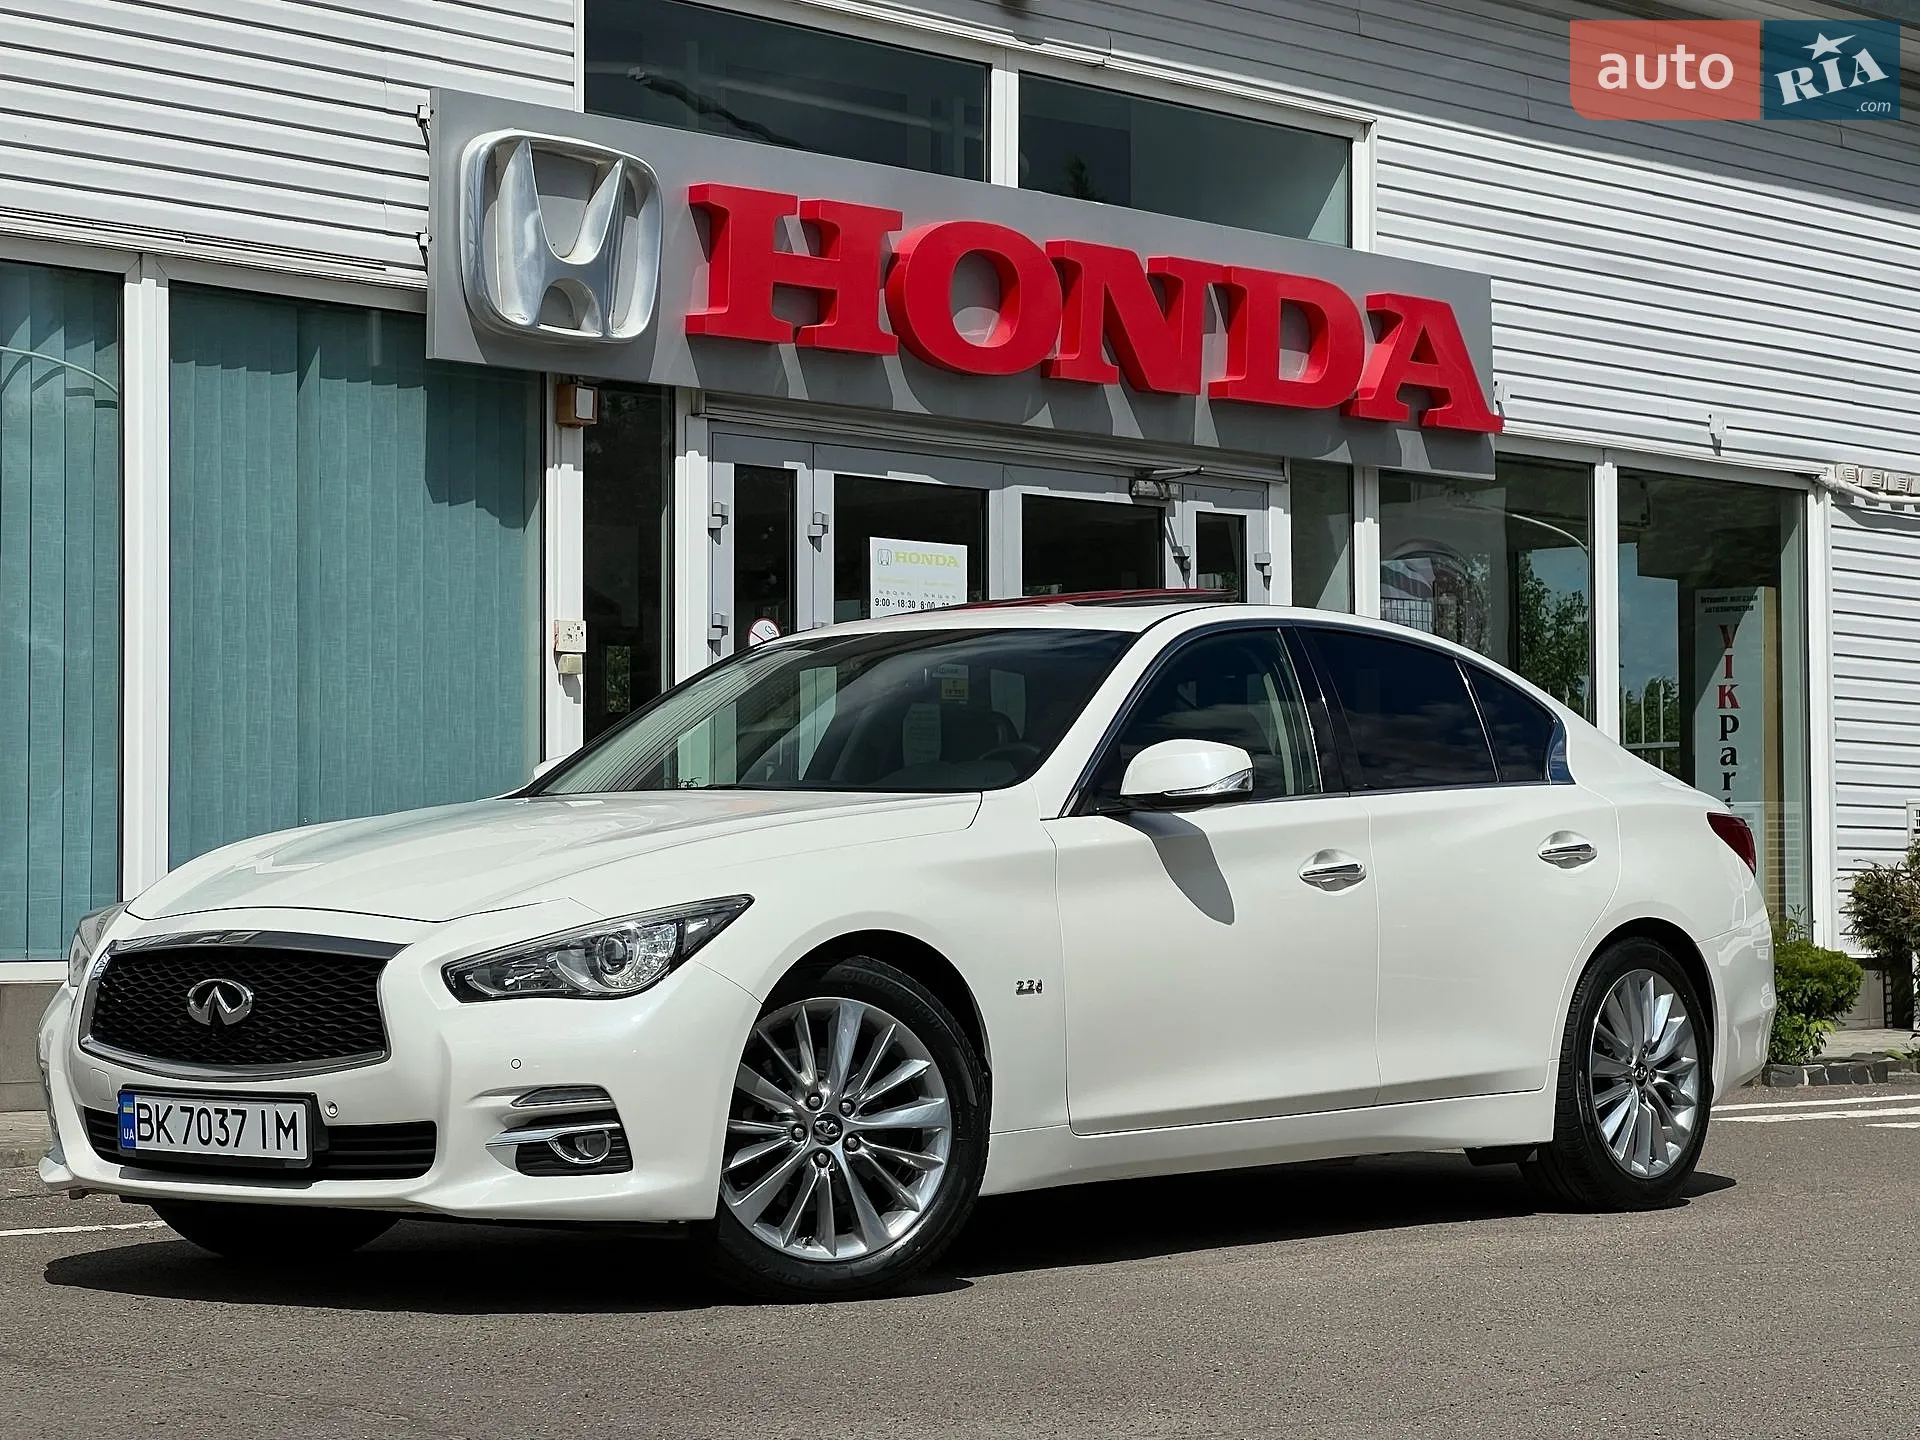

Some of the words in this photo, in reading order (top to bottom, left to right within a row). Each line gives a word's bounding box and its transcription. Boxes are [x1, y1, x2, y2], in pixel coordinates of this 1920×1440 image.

[685, 183, 1504, 434] HONDA
[895, 551, 959, 568] HONDA
[874, 597, 891, 607] 9:00
[897, 599, 916, 609] 18:30
[123, 1127, 135, 1140] UA
[136, 1102, 175, 1144] BK
[179, 1105, 248, 1148] 7037
[260, 1109, 299, 1151] IM
